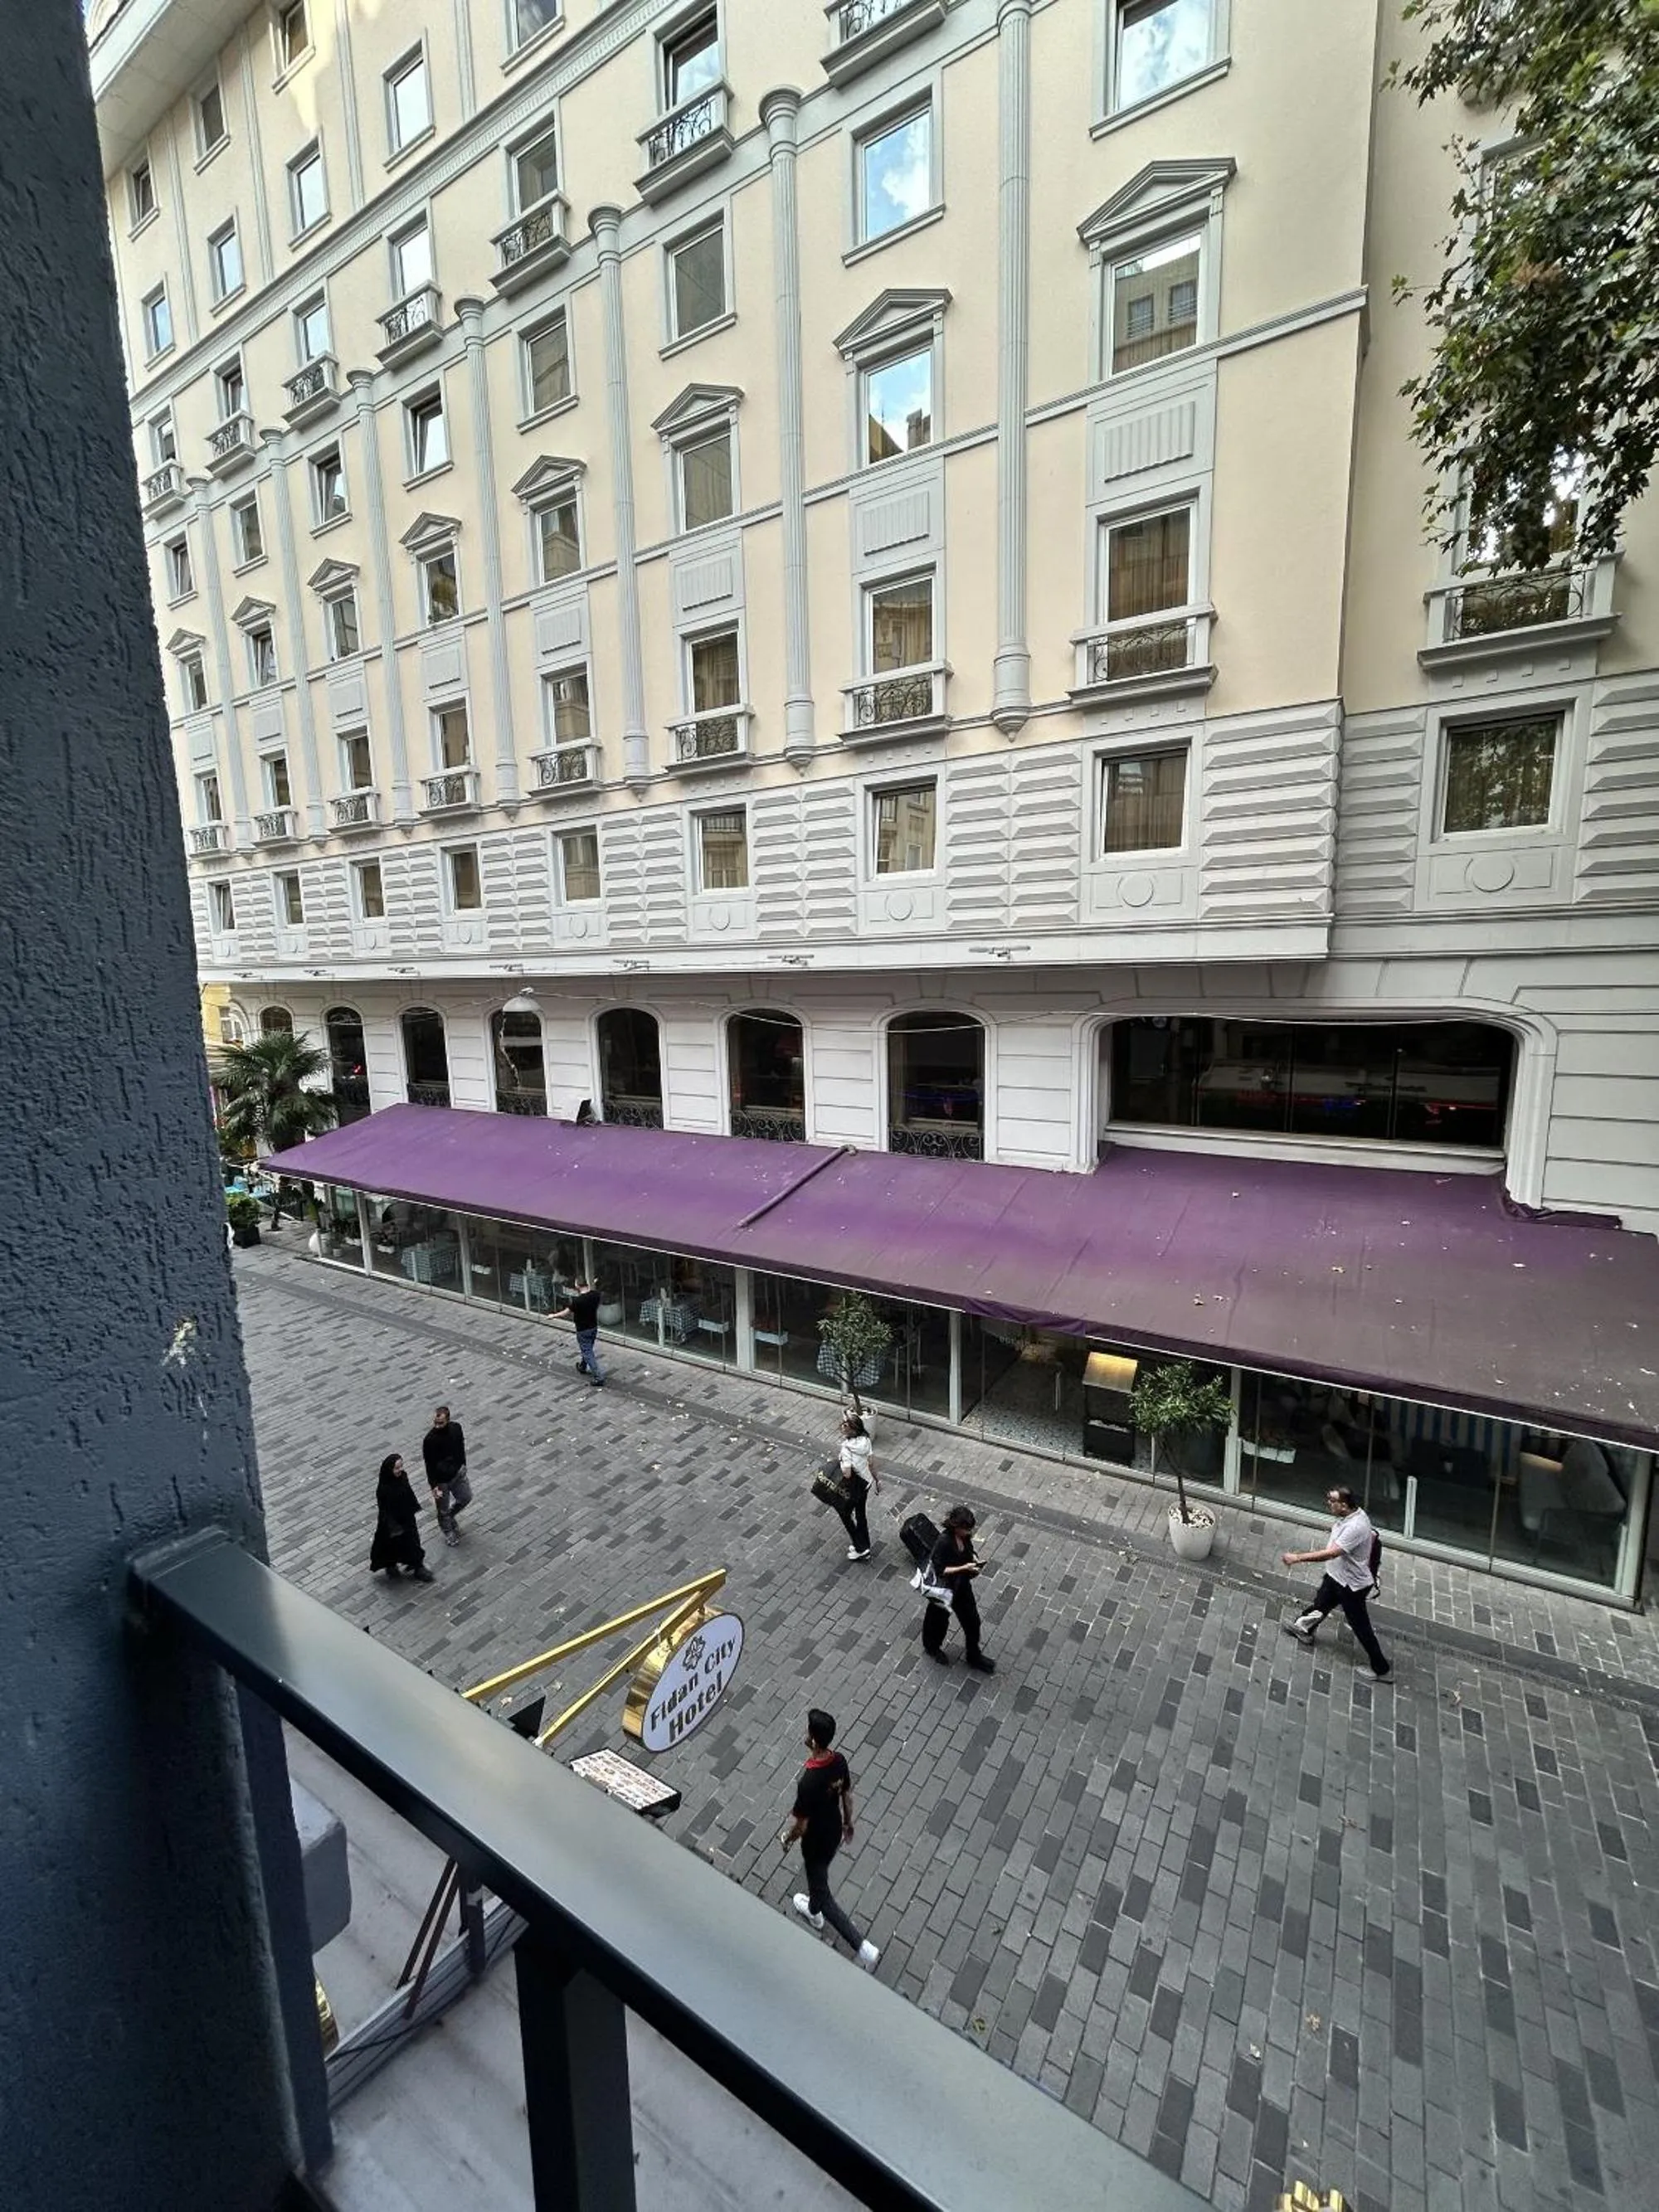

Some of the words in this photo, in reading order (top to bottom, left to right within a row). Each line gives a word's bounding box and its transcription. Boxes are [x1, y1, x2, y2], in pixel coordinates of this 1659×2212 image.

[650, 1671, 698, 1732] Fidan
[704, 1635, 736, 1674] City
[669, 1670, 722, 1743] Hotel
